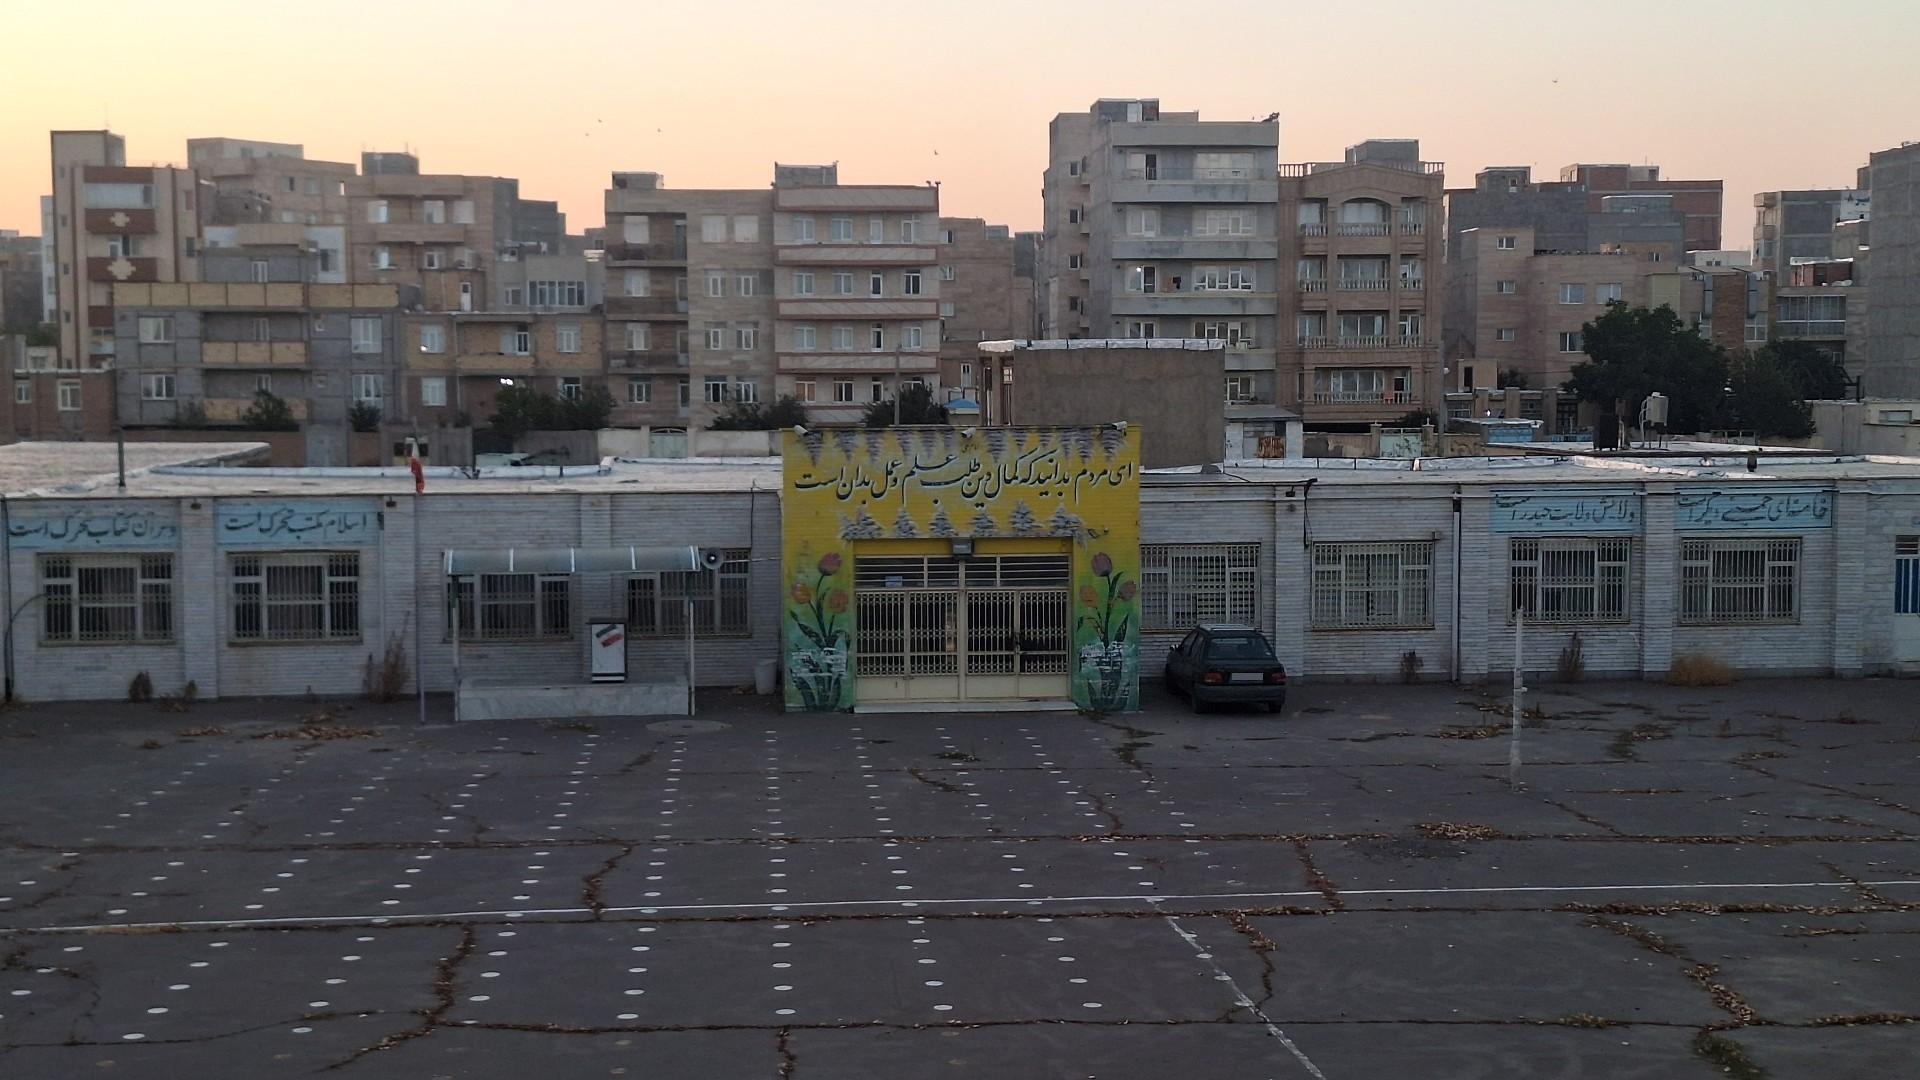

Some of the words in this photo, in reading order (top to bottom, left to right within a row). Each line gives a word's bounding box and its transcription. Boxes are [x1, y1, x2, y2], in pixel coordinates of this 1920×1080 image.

[794, 465, 847, 489] است
[871, 459, 902, 499] عمل
[890, 476, 898, 488] و
[902, 453, 958, 506] علم
[920, 458, 980, 505] طلب
[984, 447, 1038, 499] کمال
[1020, 449, 1057, 484] که
[1031, 458, 1071, 497] بدانید
[1108, 461, 1132, 486] ای
[837, 464, 871, 505] بدان
[961, 471, 991, 508] دین
[1074, 468, 1108, 504] مردم
[8, 521, 49, 537] است
[224, 511, 262, 531] است
[287, 509, 330, 540] مکتب
[324, 512, 367, 540] اسلام
